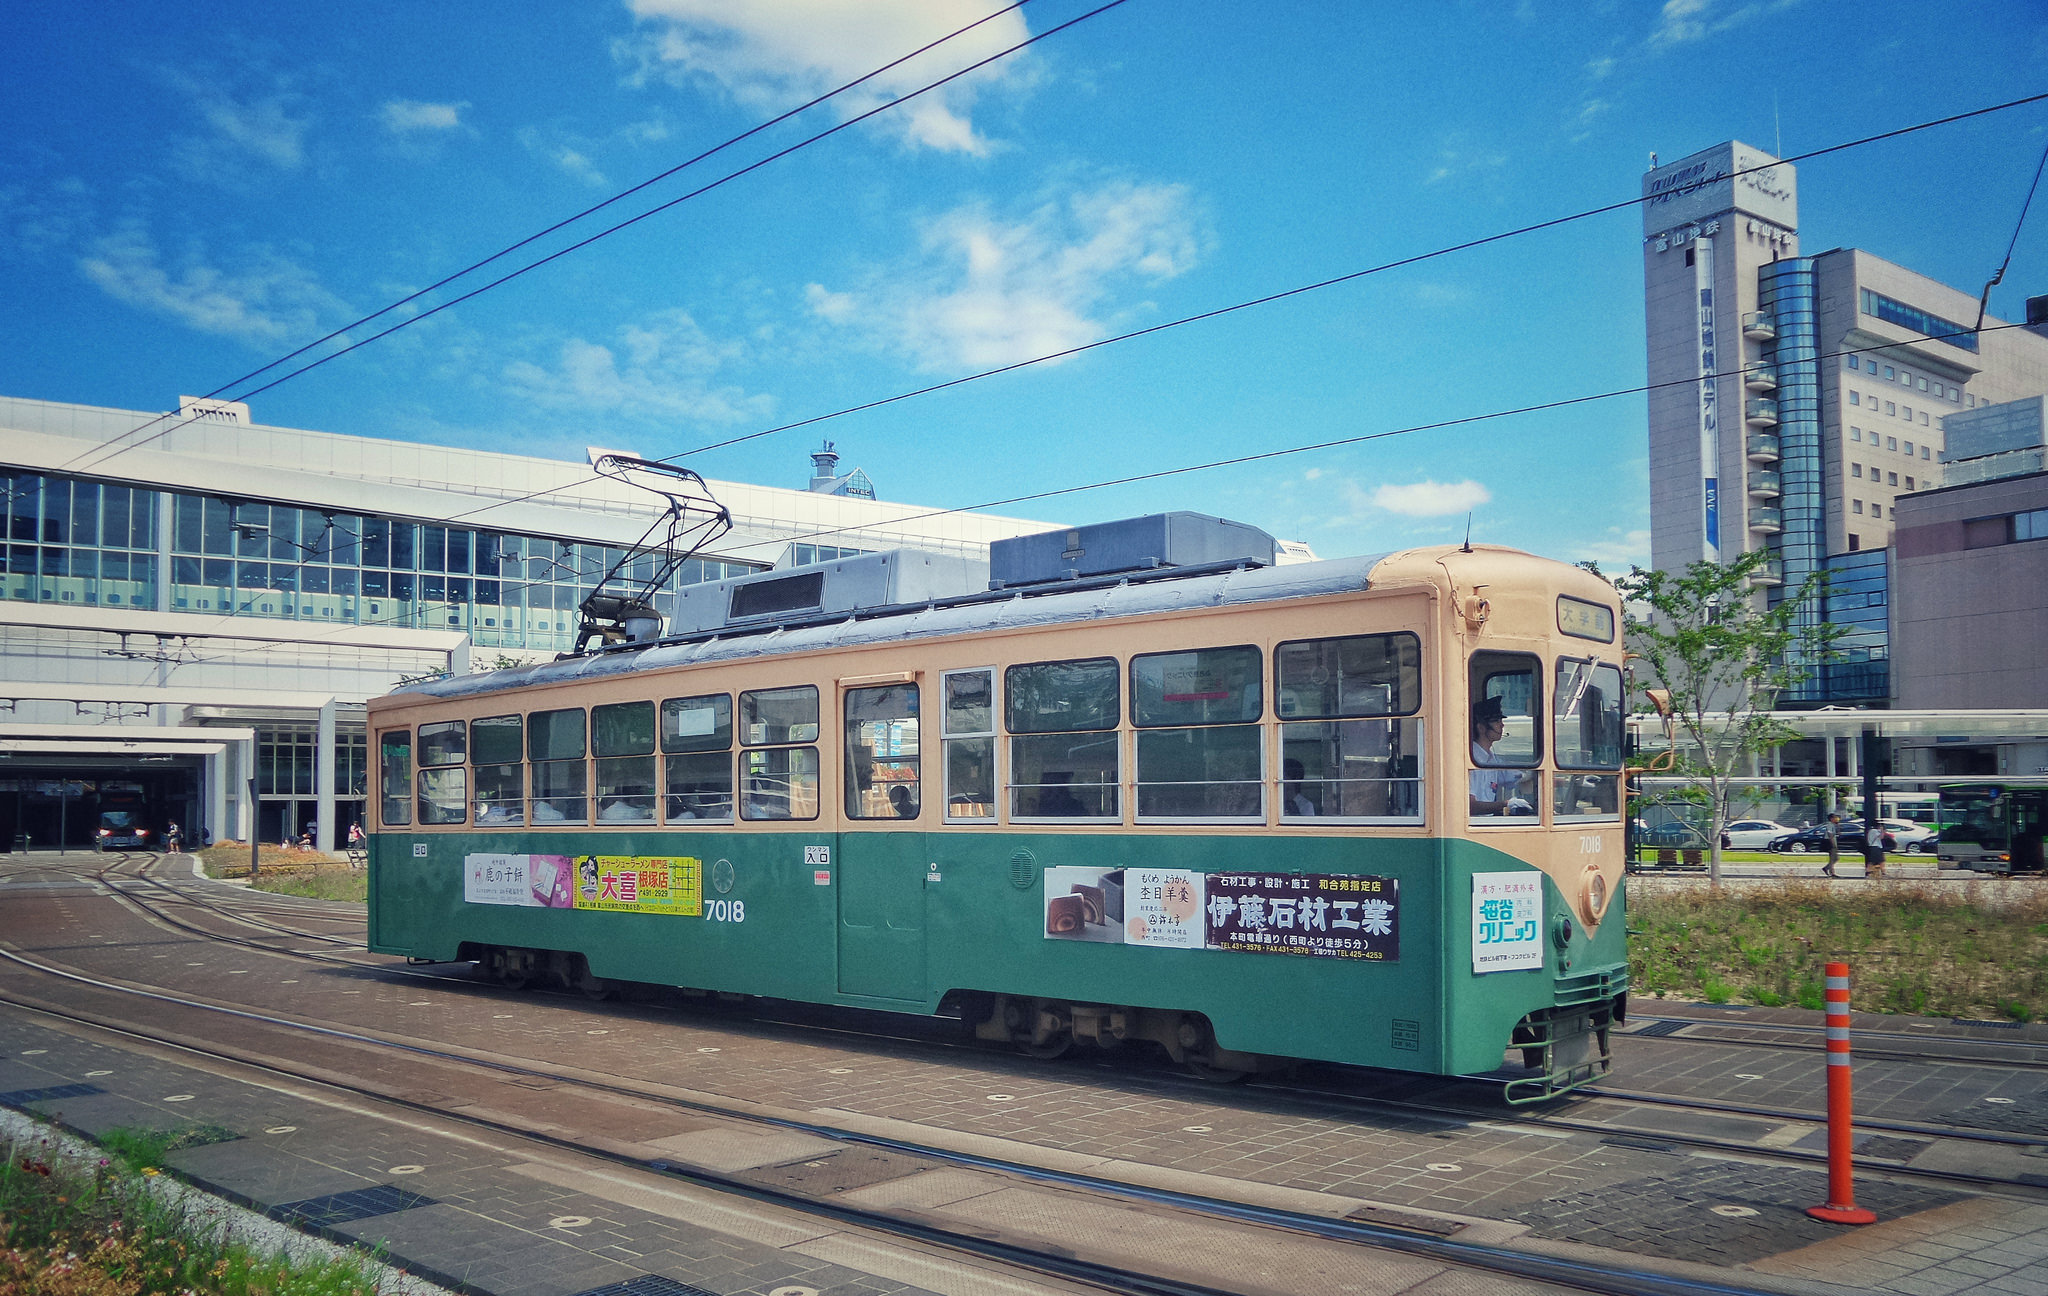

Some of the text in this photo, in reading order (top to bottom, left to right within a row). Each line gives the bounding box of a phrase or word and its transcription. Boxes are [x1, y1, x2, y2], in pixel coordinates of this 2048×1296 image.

[847, 487, 871, 496] INTEC
[1579, 836, 1601, 854] 7018
[806, 853, 828, 863] 入口
[486, 866, 523, 883] 鹿の子餅
[638, 871, 669, 888] 根塚店
[1163, 874, 1190, 885] ようかん
[600, 870, 638, 902] 大喜
[1318, 879, 1381, 892] 和合苑指定店
[704, 899, 746, 923] 7018
[1207, 894, 1395, 936] 伊藤石材工業
[1480, 899, 1514, 921] 笹谷
[1480, 920, 1537, 944] クリニック
